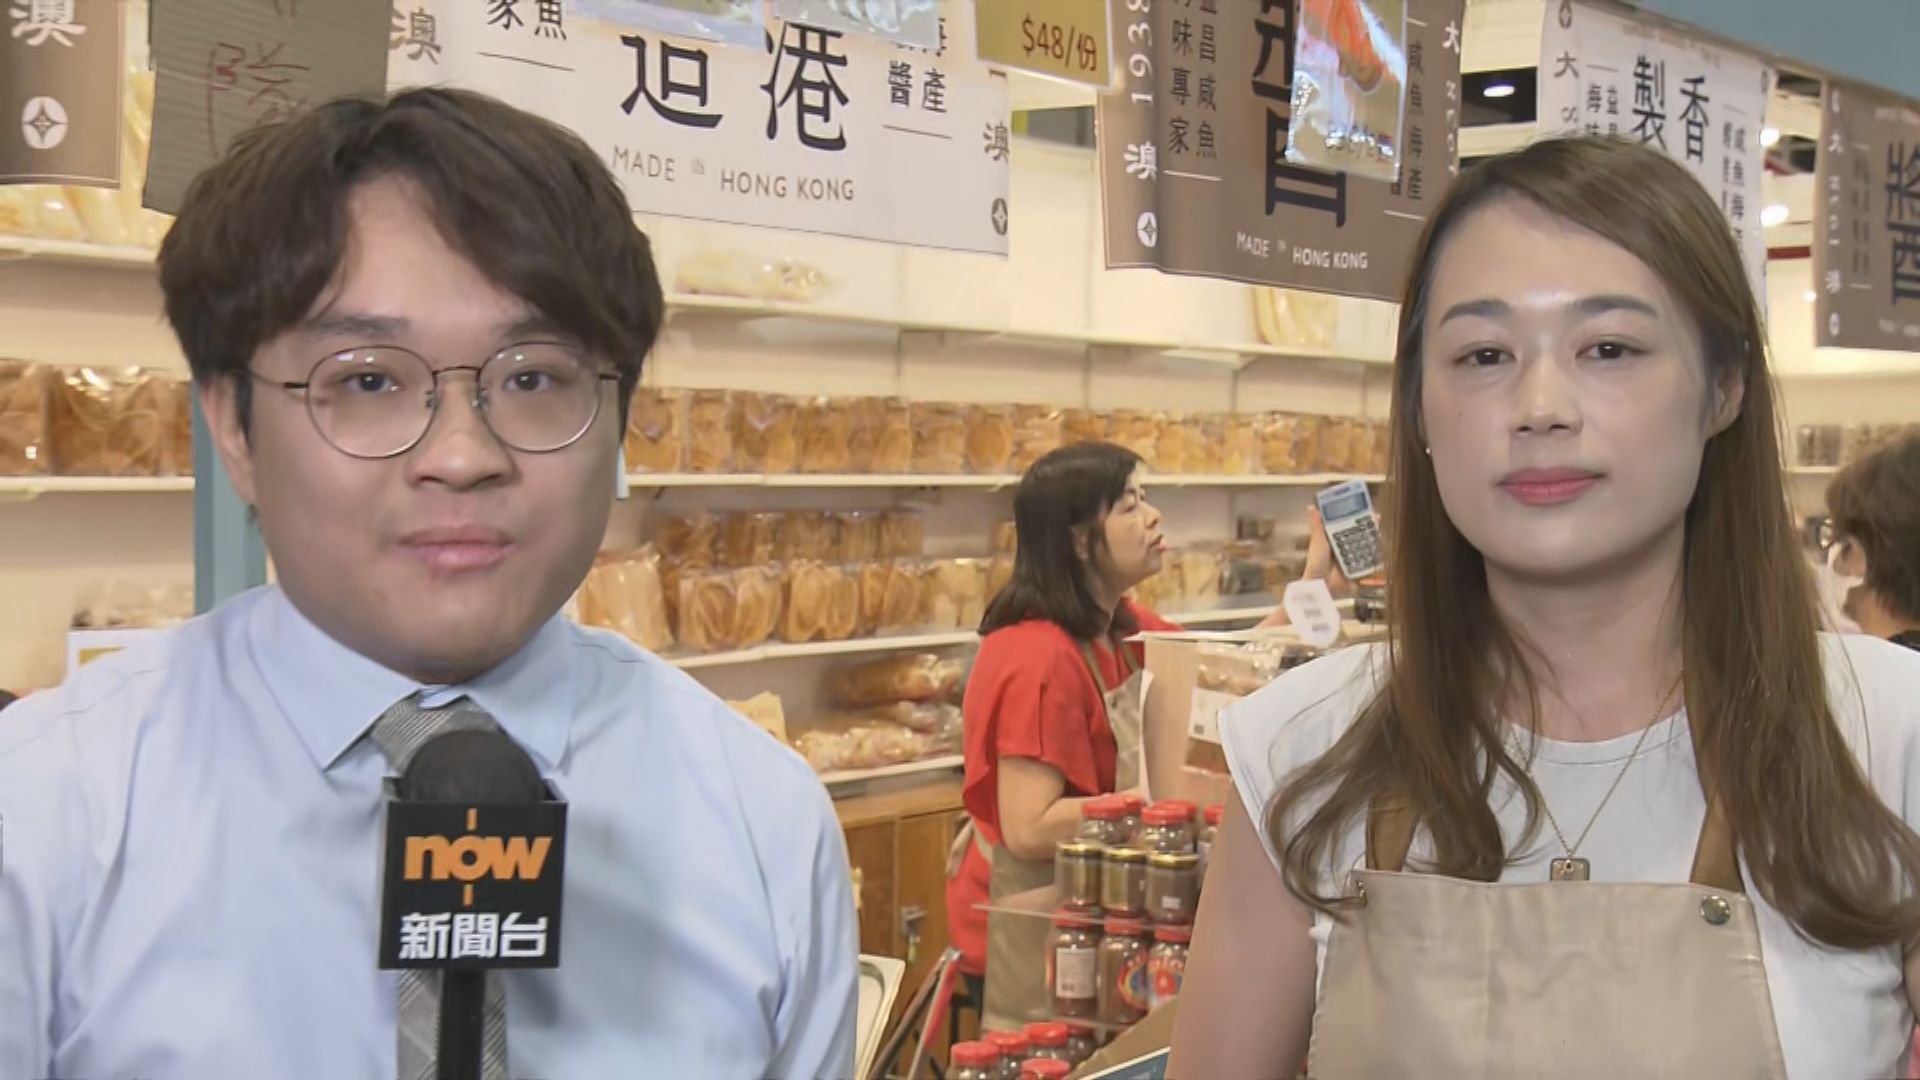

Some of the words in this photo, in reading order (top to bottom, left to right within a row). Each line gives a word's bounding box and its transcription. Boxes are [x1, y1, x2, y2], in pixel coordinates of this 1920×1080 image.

[390, 7, 441, 65] 澳
[1022, 13, 1098, 71] $48/份
[1442, 20, 1460, 55] 大
[759, 20, 850, 151] 港
[1168, 0, 1193, 154] 味專家
[1553, 51, 1579, 78] 大
[1630, 55, 1667, 150] 製
[1679, 75, 1710, 165] 香
[983, 121, 1010, 164] 澳
[1123, 141, 1158, 180] 澳
[613, 146, 676, 182] MADE
[720, 168, 788, 199] HONG
[796, 176, 854, 201] KONG
[1236, 230, 1270, 259] MADE
[1292, 245, 1331, 268] HONG
[1332, 251, 1369, 270] KONG
[403, 835, 553, 880] now
[399, 912, 548, 959] 新聞台
